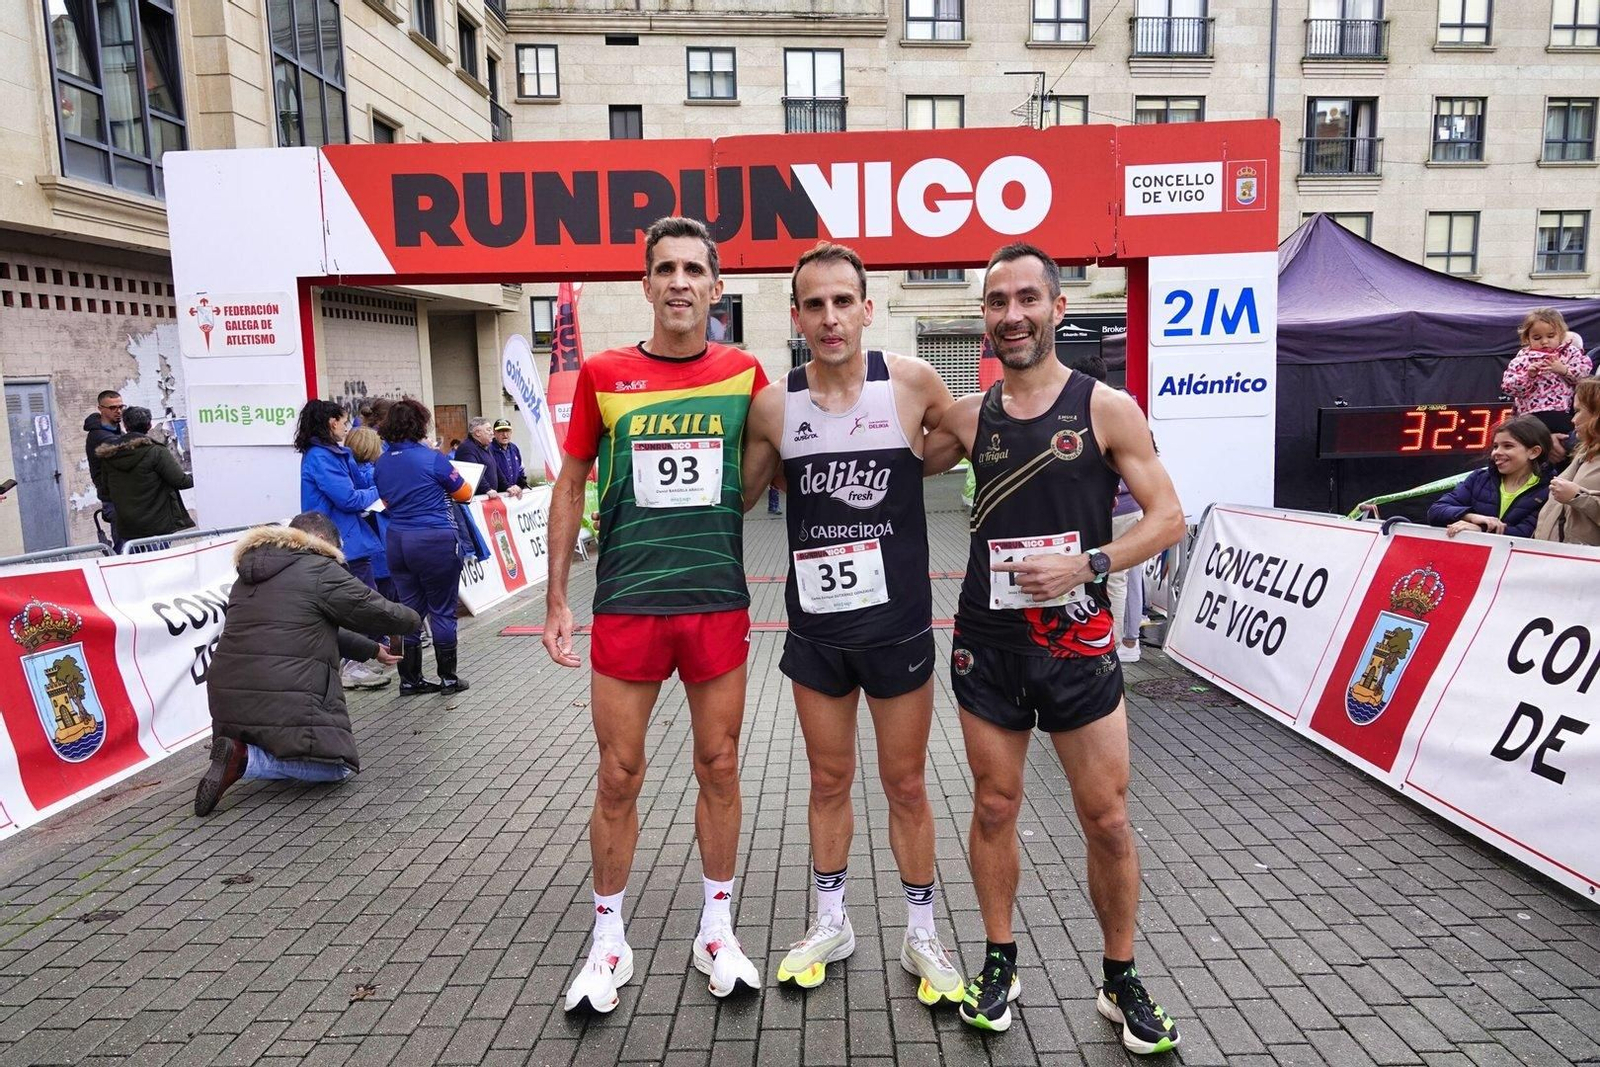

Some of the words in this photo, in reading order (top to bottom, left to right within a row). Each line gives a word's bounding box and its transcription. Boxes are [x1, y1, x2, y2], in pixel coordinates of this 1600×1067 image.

[1132, 173, 1214, 188] CONCELLO
[1142, 191, 1162, 203] DE
[1168, 189, 1204, 202] VIGO
[223, 303, 279, 316] FEDERACIÓN
[225, 320, 259, 331] GALEGA
[261, 319, 272, 330] DE
[226, 334, 276, 346] ATLETISMO
[1158, 371, 1267, 396] Atlántico
[199, 404, 238, 423] máis
[255, 406, 295, 426] auga
[629, 413, 725, 436] BIKILA
[658, 456, 699, 485] 93
[800, 459, 891, 495] delikia
[848, 490, 873, 501] fresh
[530, 536, 546, 558] DE
[818, 560, 858, 593] 35
[1205, 542, 1329, 609] CONCELLO
[1195, 590, 1227, 631] DE
[1226, 600, 1287, 656] VIGO
[1490, 701, 1590, 785] DE
